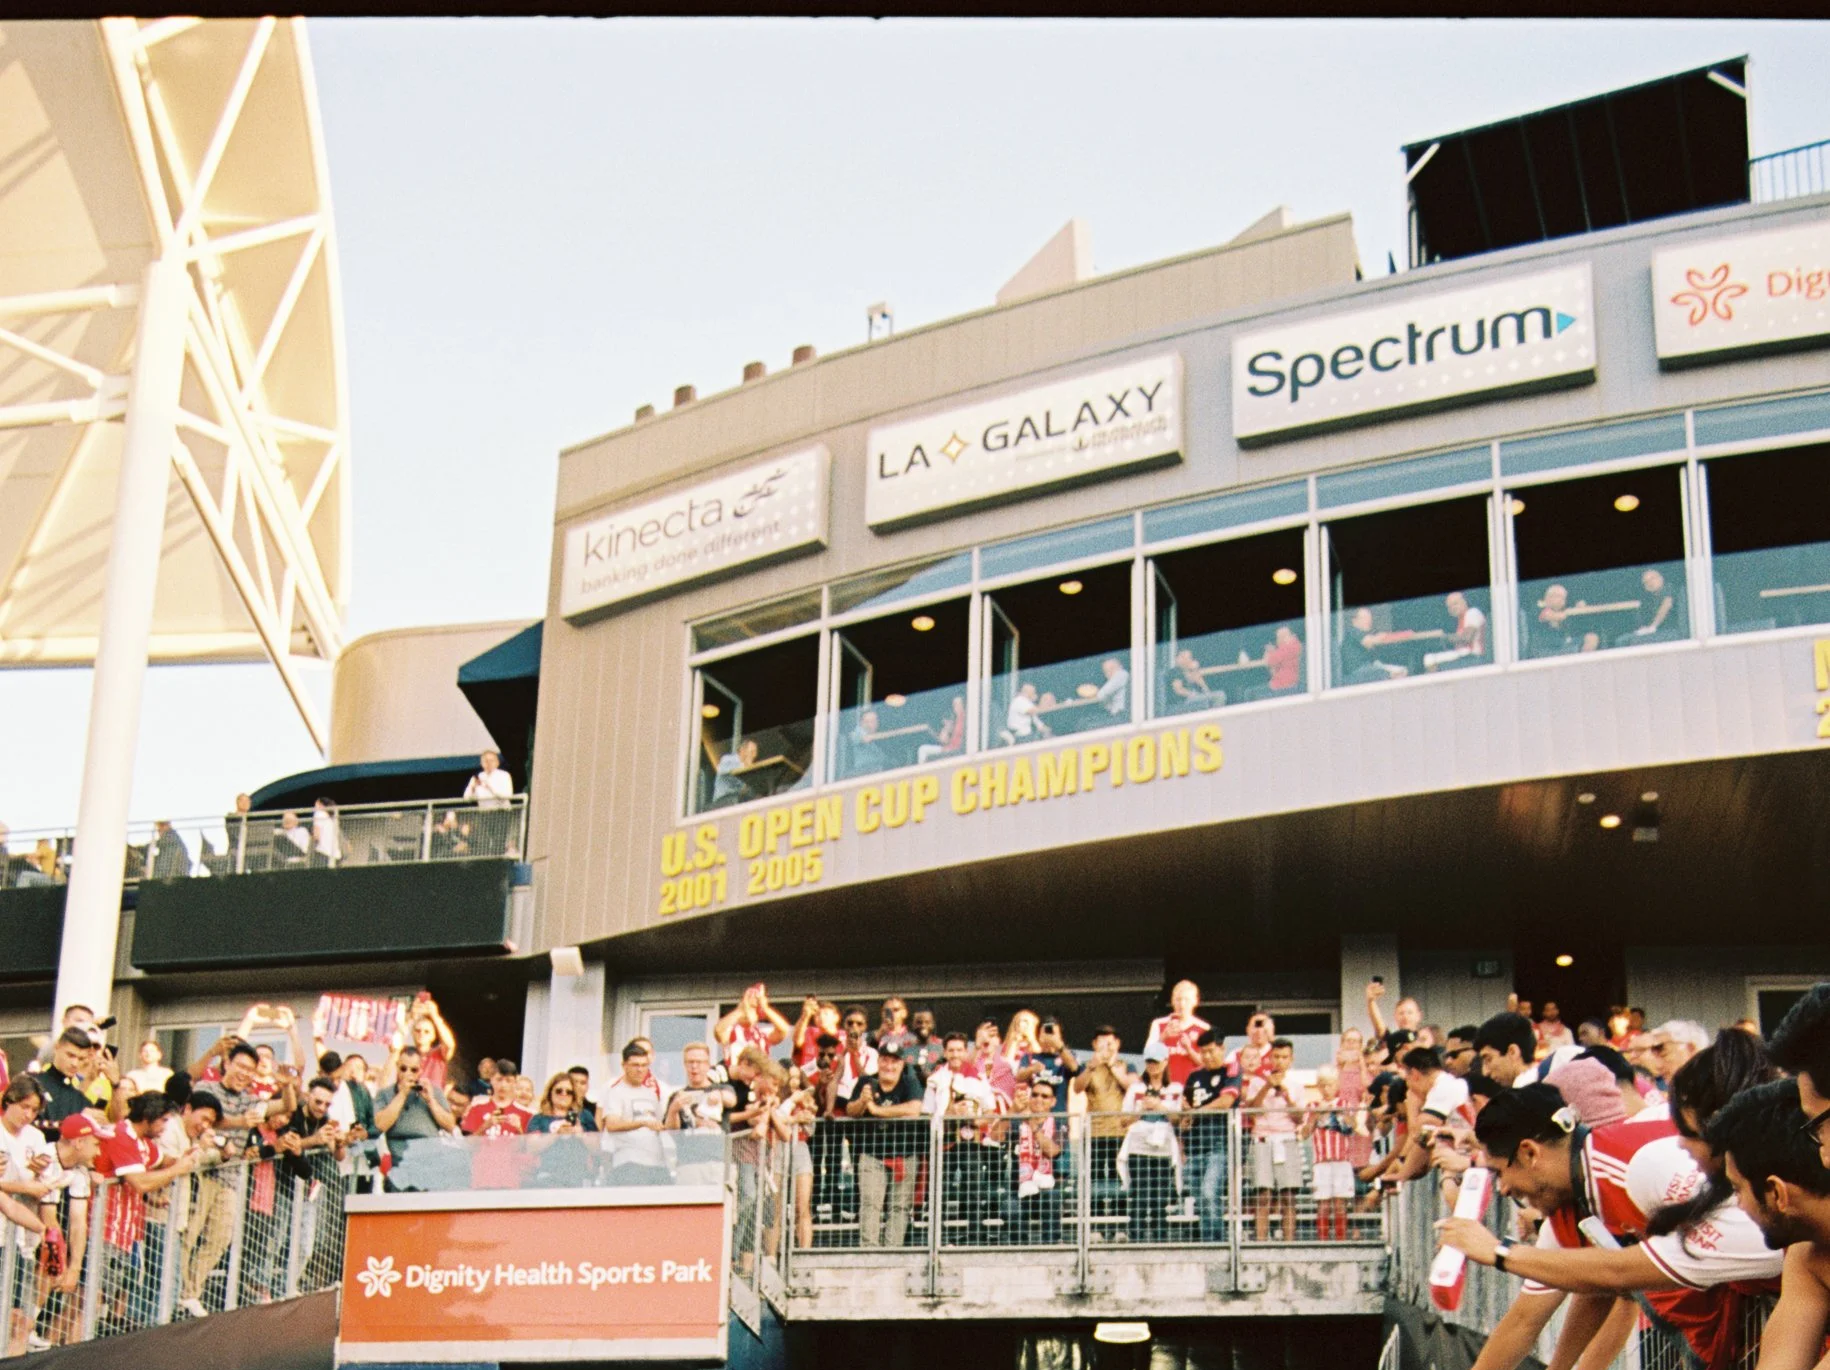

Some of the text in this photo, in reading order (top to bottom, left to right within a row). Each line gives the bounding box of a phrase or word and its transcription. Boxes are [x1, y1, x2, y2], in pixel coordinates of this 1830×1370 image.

[1766, 265, 1830, 300] Dig
[1247, 305, 1553, 402] Spectrum
[878, 443, 932, 480] LA
[982, 380, 1164, 453] GALAXY
[584, 498, 723, 567] kinecta
[659, 724, 1225, 877] U.S. OPEN CUP CHAMPIONS
[658, 849, 823, 915] 2001 2005
[405, 1258, 712, 1294] Dignity Health Sports Park
